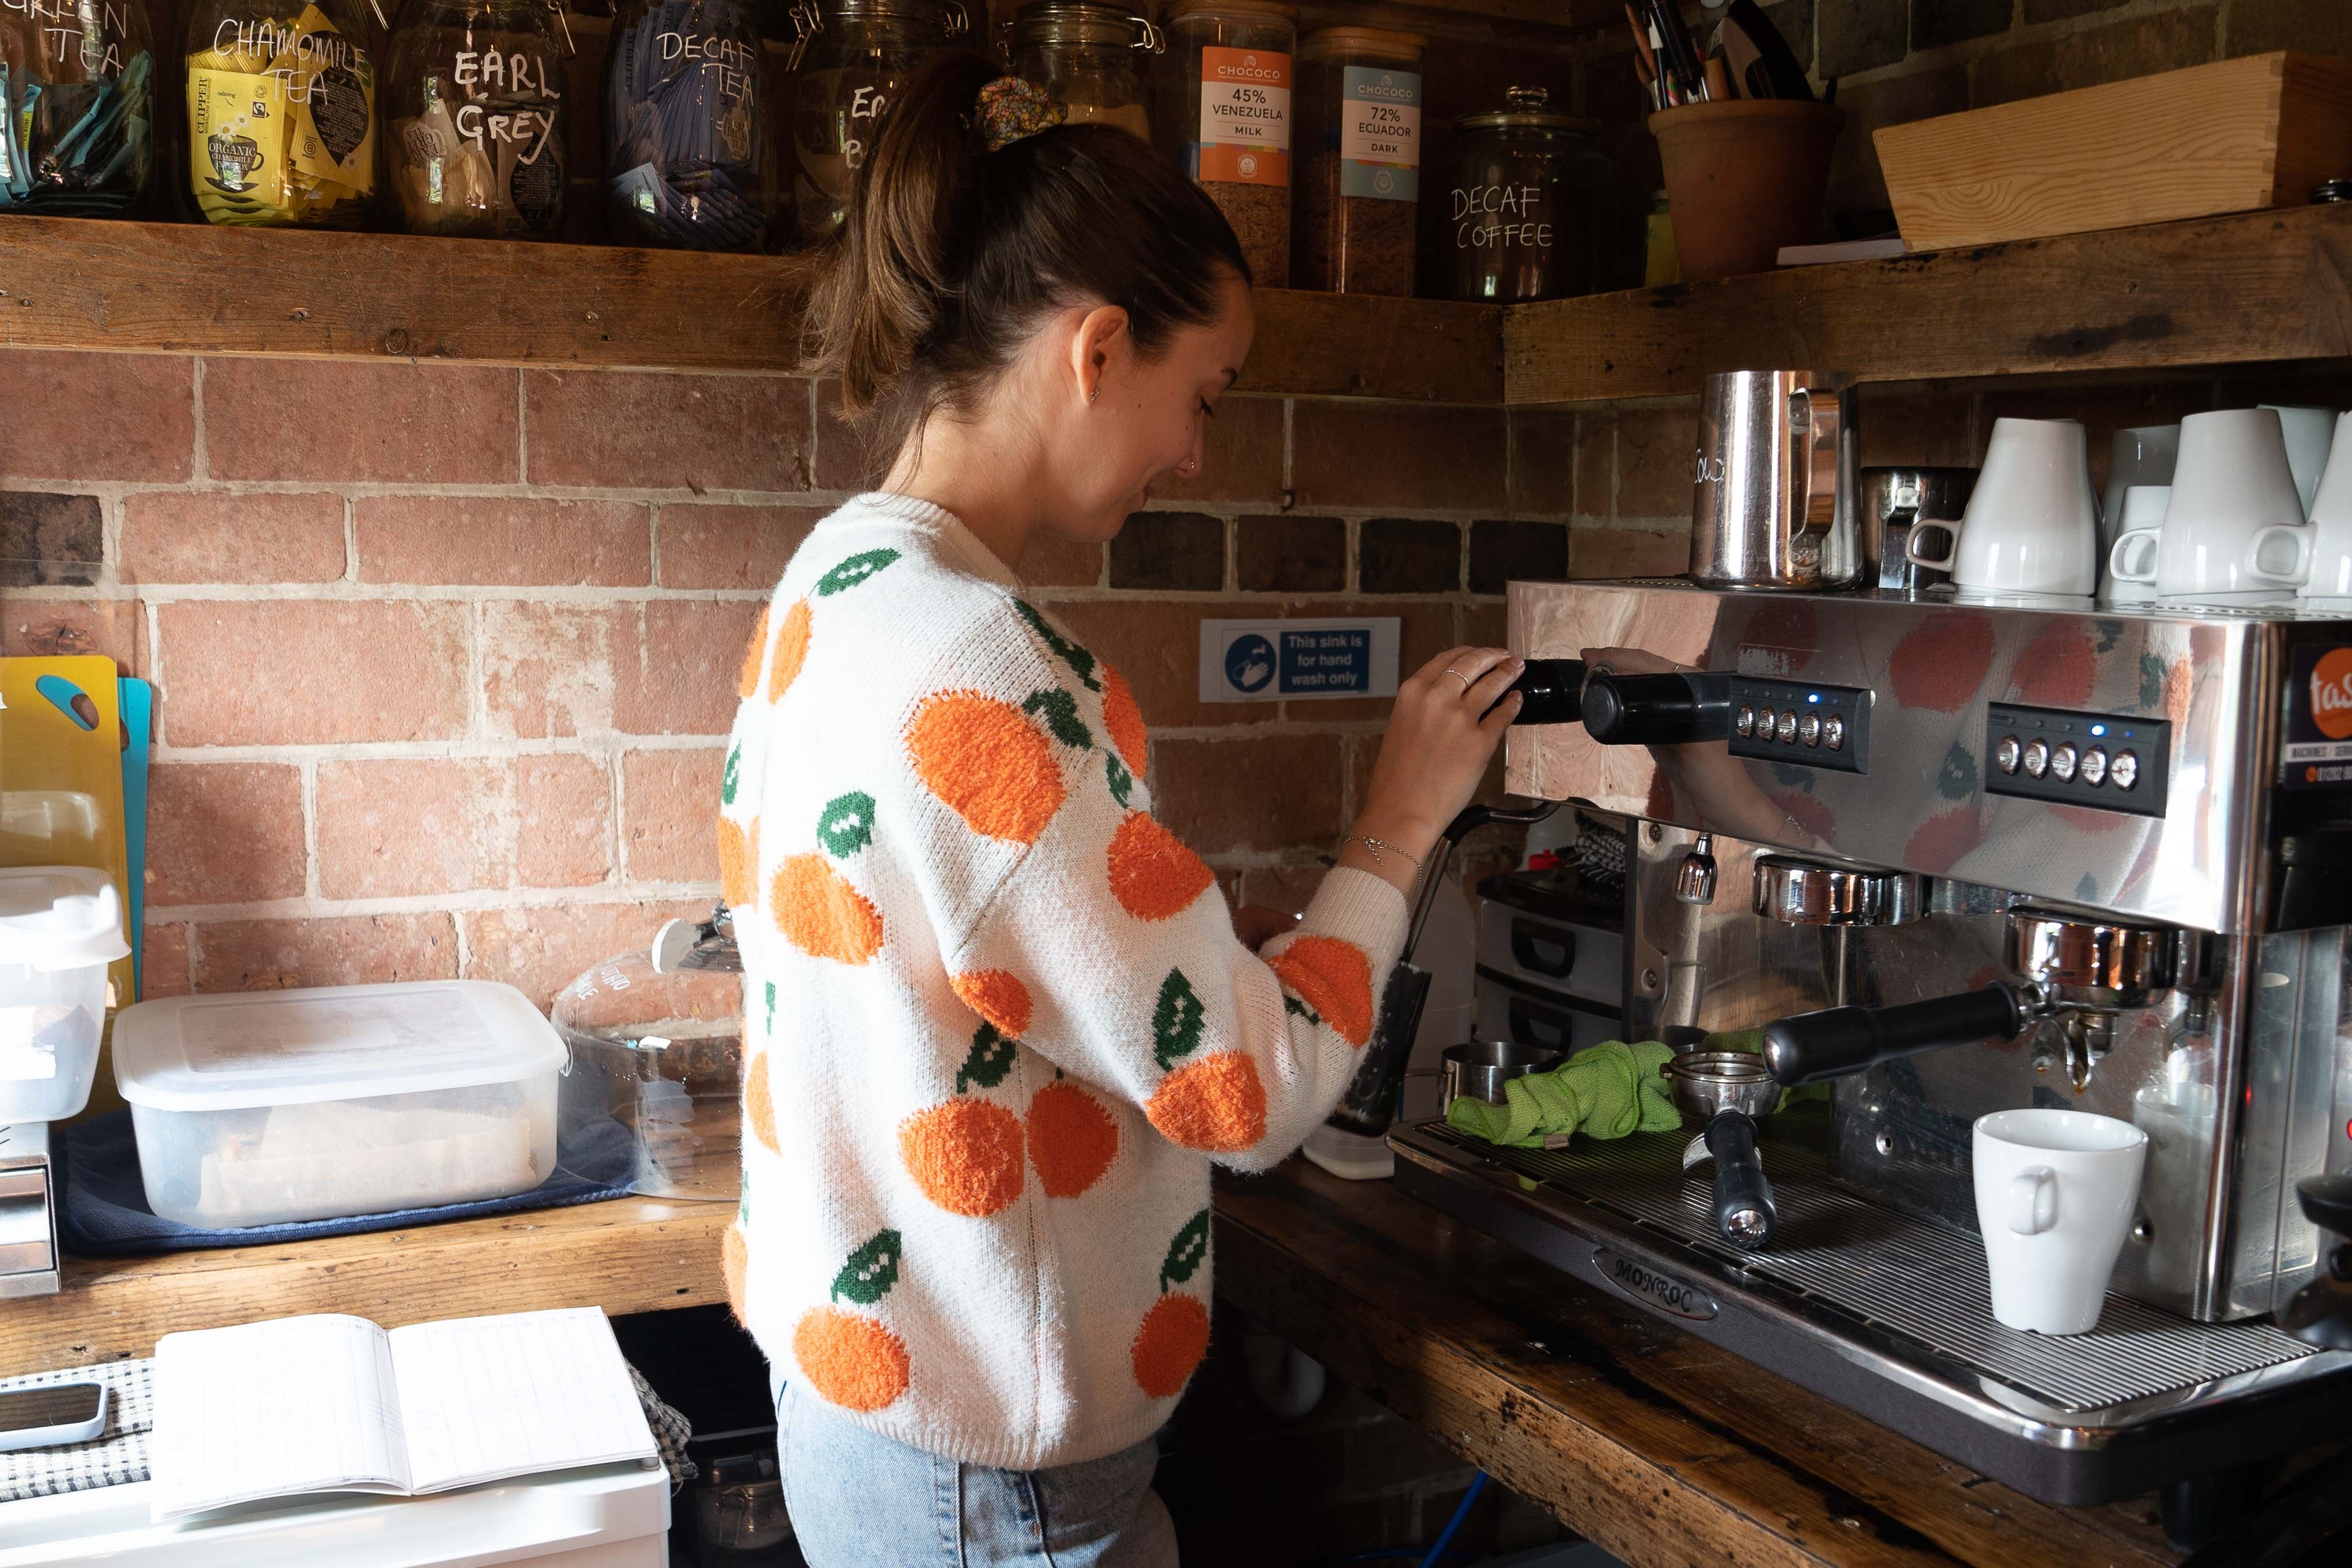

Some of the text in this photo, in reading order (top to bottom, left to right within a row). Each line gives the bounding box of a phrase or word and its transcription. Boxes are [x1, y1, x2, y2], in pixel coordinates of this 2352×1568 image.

[44, 27, 124, 78] TEA
[213, 18, 369, 80] CHAMOMILE
[656, 32, 754, 70] DECAF
[454, 51, 561, 99] EARL
[1217, 65, 1280, 79] CHOCOCO
[259, 68, 329, 106] TEA
[701, 62, 754, 107] TEA
[1358, 84, 1413, 98] CHOCOCO
[1232, 88, 1266, 104] 45%
[1212, 104, 1283, 121] VENEZUELA
[1371, 107, 1401, 123] 72%
[456, 104, 555, 165] GREY
[1235, 126, 1263, 137] MILK
[1358, 122, 1411, 138] ECUADOR
[209, 142, 257, 157] ORGANIC
[1371, 143, 1399, 154] DARK
[1451, 185, 1541, 221] DECAF
[1458, 222, 1553, 249] COFFEE
[1288, 634, 1363, 648] This sink is
[1297, 652, 1352, 666] for hand
[1291, 671, 1358, 686] wash only
[1613, 1258, 1693, 1313] MONROC
